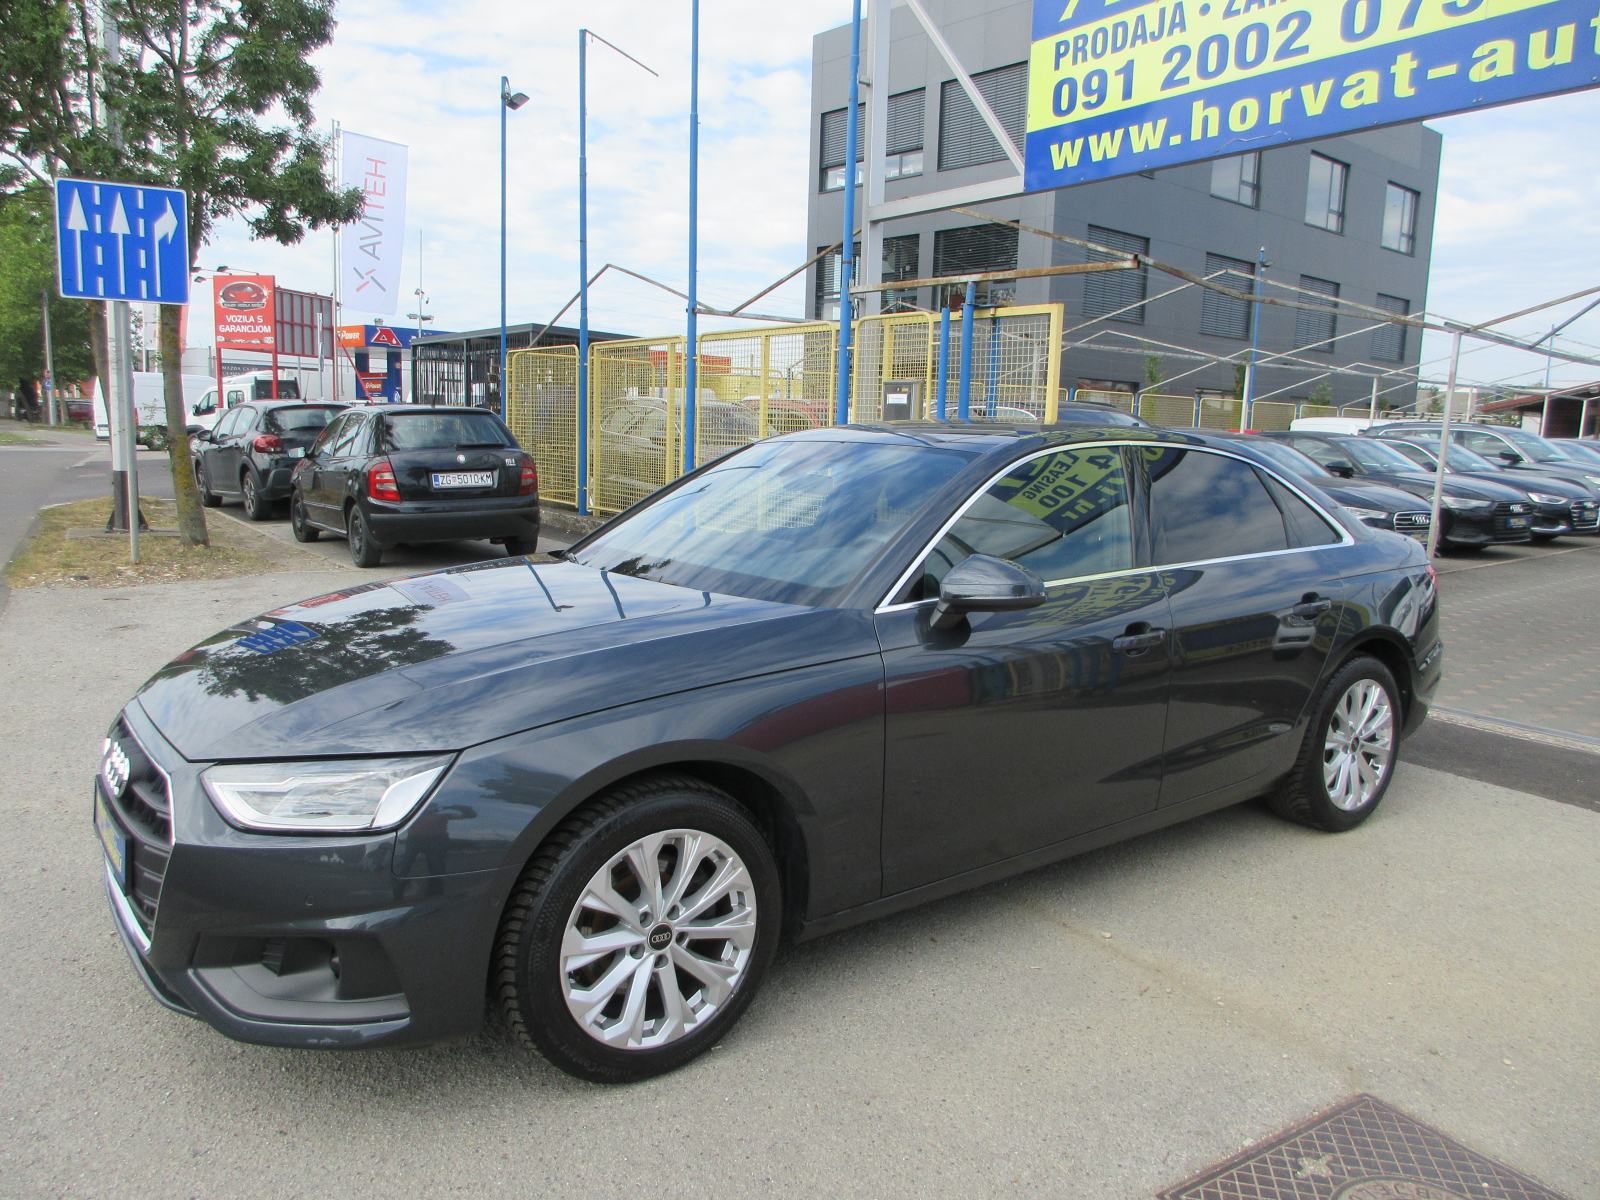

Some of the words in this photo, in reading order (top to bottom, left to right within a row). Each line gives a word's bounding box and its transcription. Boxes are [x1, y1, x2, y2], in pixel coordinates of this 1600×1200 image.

[1053, 1, 1187, 71] PRODAJA
[1052, 58, 1134, 118] 091
[1159, 10, 1312, 92] 2002
[219, 324, 272, 333] GARANCIJOM
[225, 315, 255, 323] VOZILA
[257, 315, 264, 323] S
